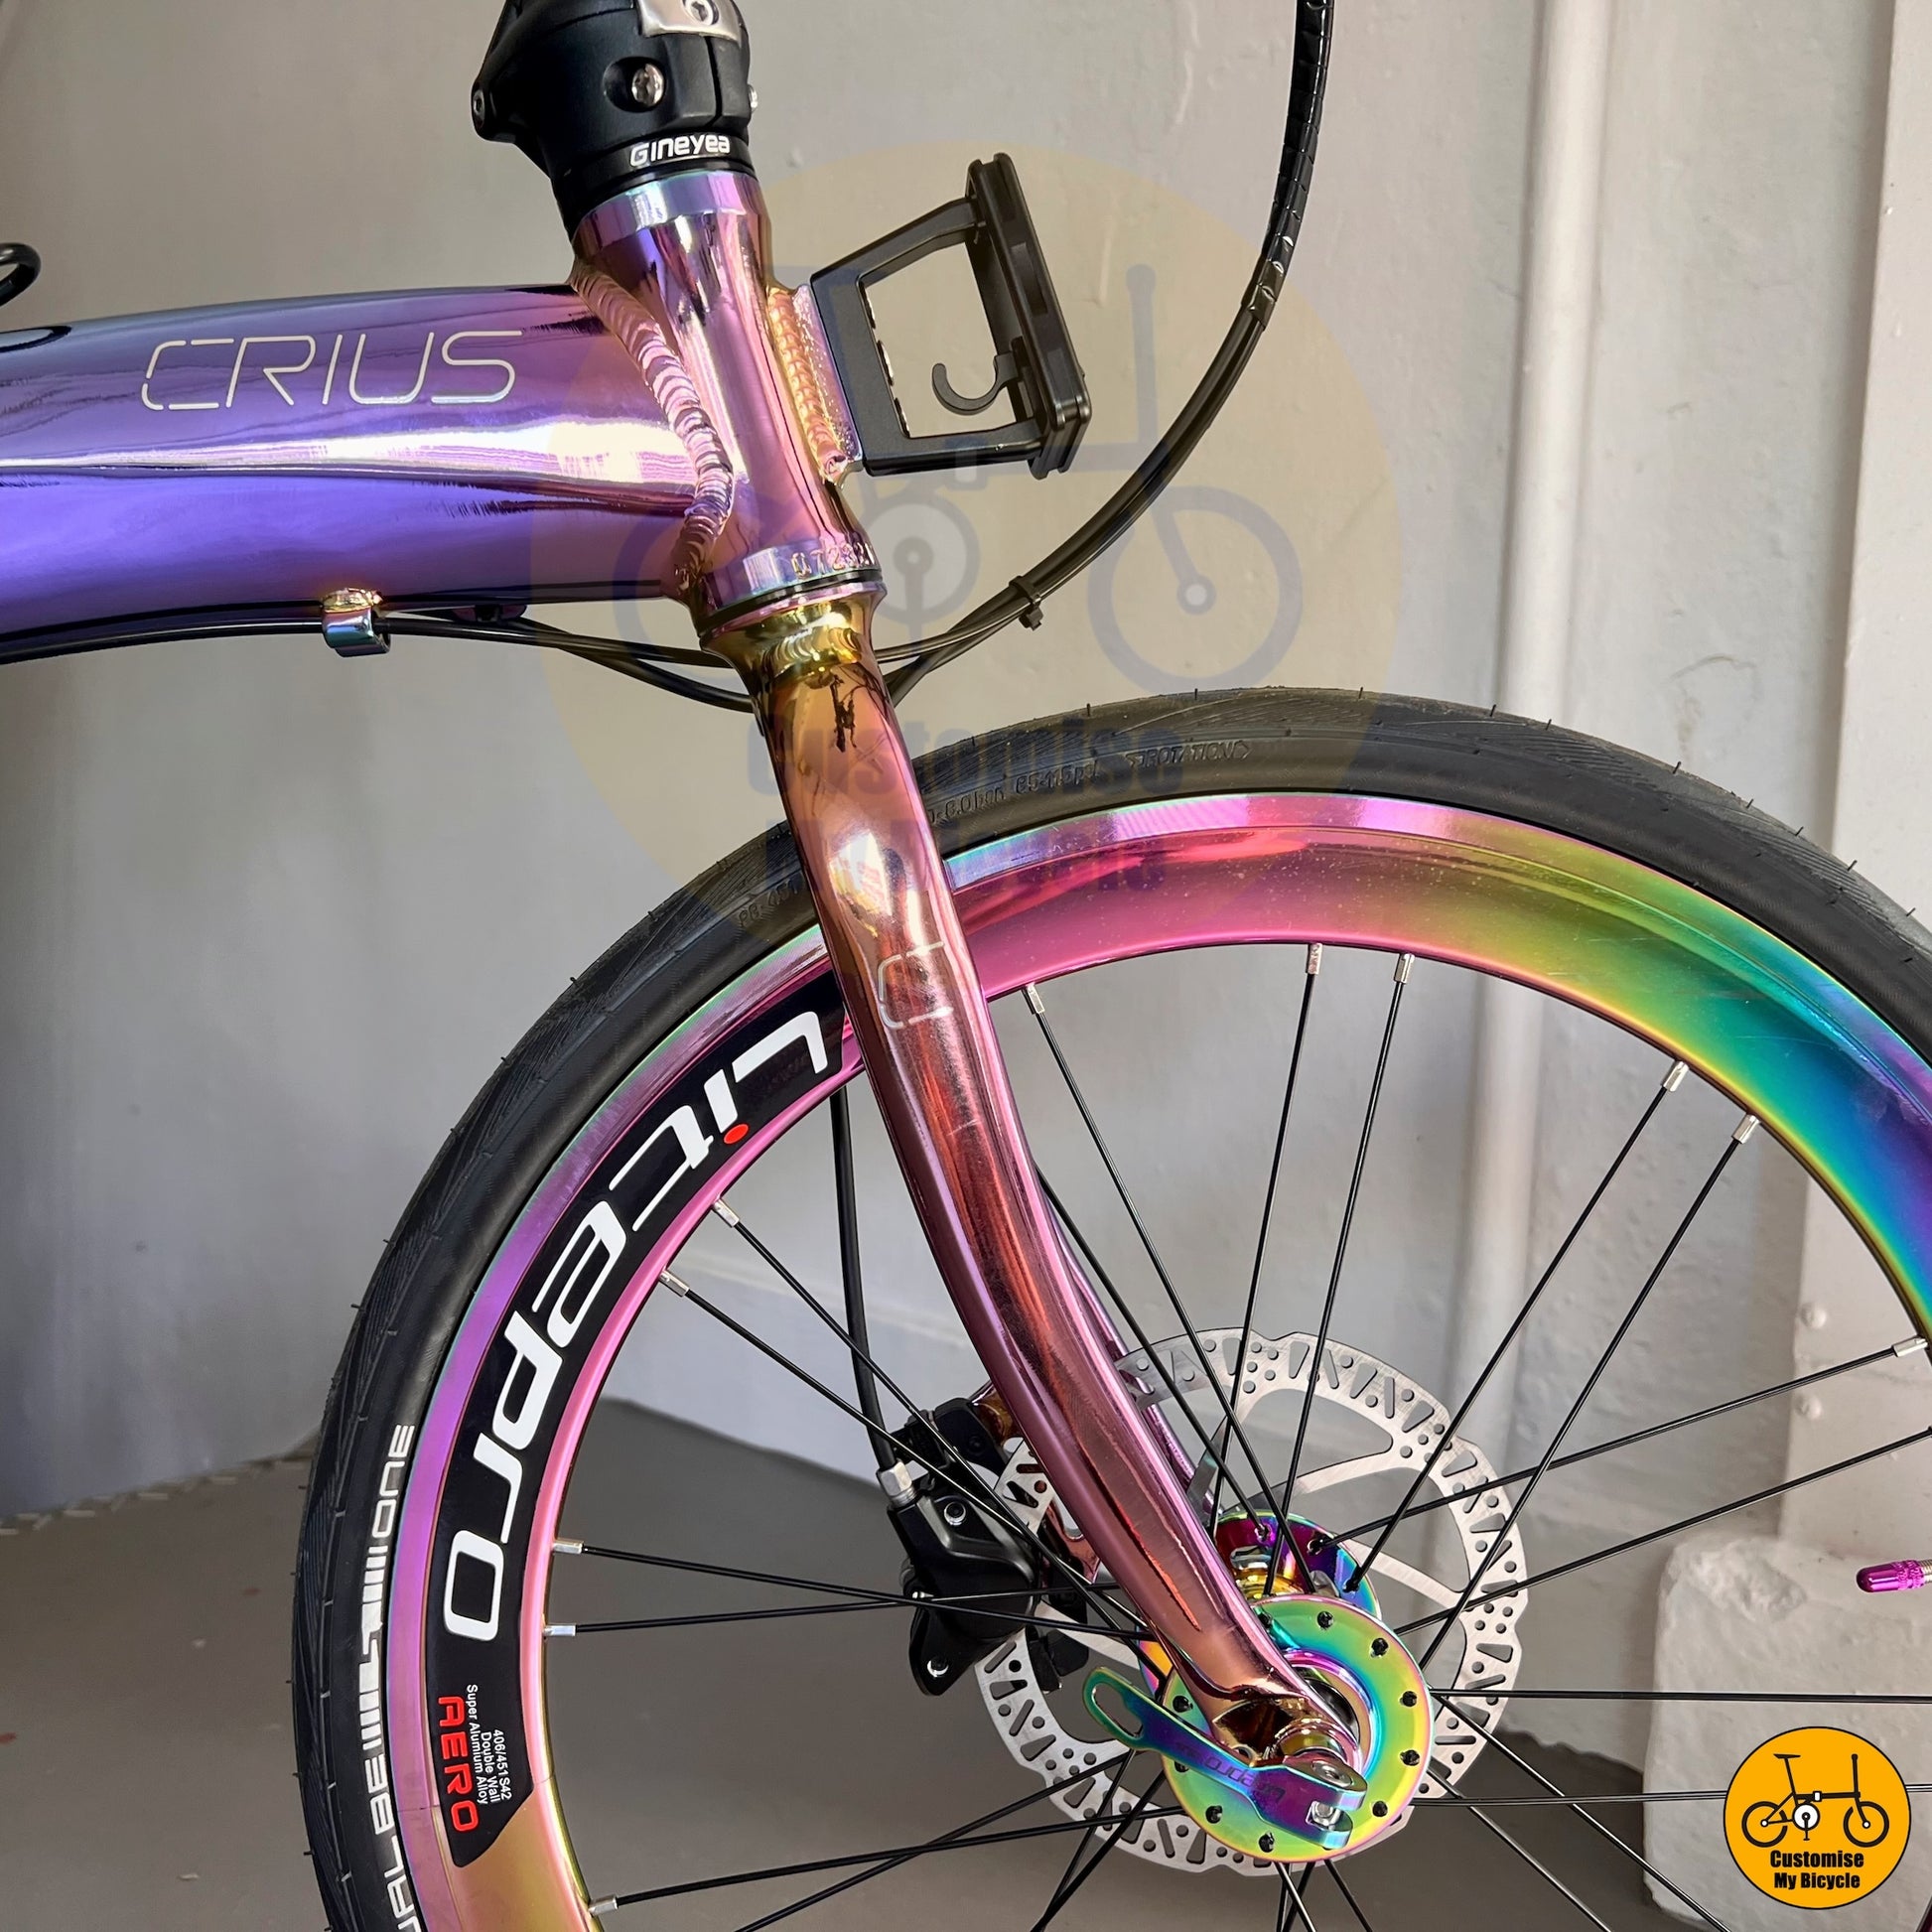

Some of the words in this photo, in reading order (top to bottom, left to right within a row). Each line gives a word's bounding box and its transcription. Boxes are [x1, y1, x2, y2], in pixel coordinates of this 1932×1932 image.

[629, 134, 731, 168] Gineyea
[141, 331, 523, 411] CRIUS
[1145, 740, 1236, 768] ROTATION
[371, 1425, 415, 1538] ONE
[466, 1684, 479, 1720] Super
[438, 1696, 480, 1832] AERO
[469, 1722, 483, 1773] Alumium
[481, 1731, 495, 1774] Double
[477, 1776, 489, 1805] Alloy
[487, 1775, 501, 1803] Wall
